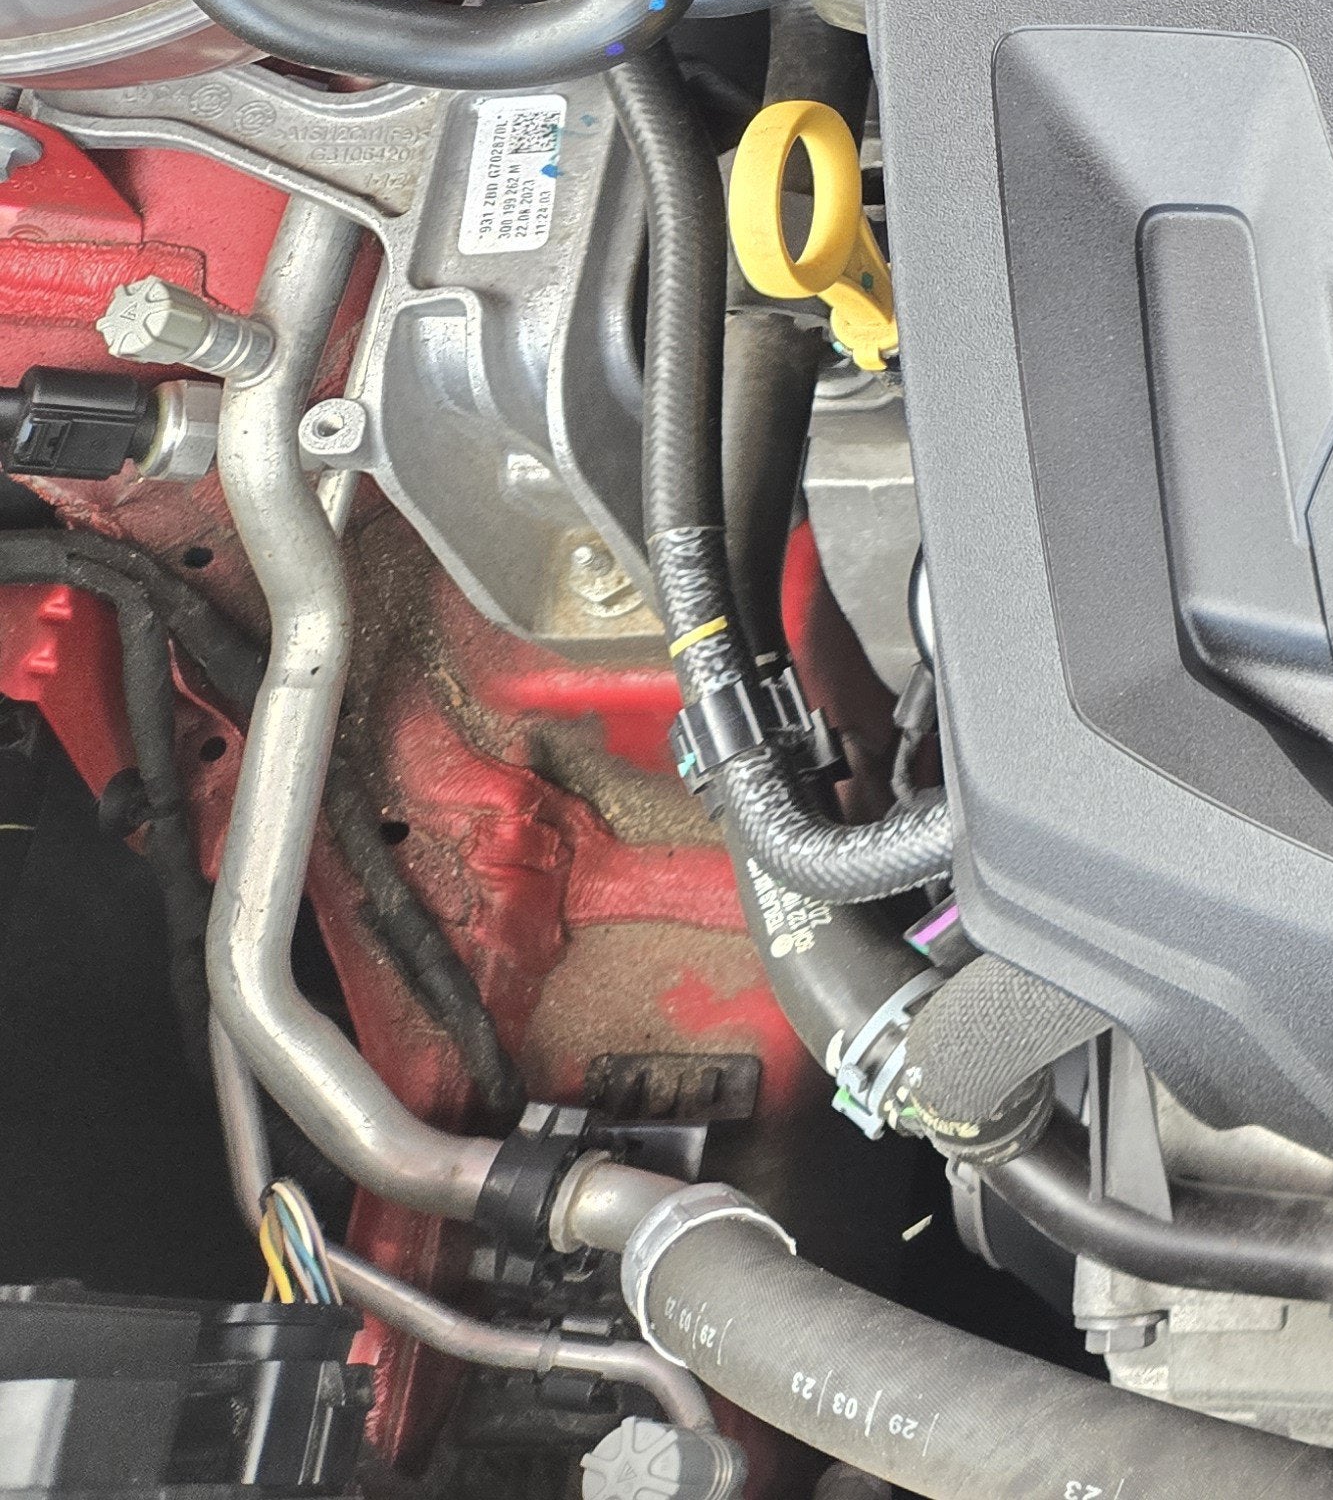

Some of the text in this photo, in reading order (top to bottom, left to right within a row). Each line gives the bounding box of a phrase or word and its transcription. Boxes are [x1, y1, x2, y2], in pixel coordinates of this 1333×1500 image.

[792, 1372, 919, 1440] 29 03 23
